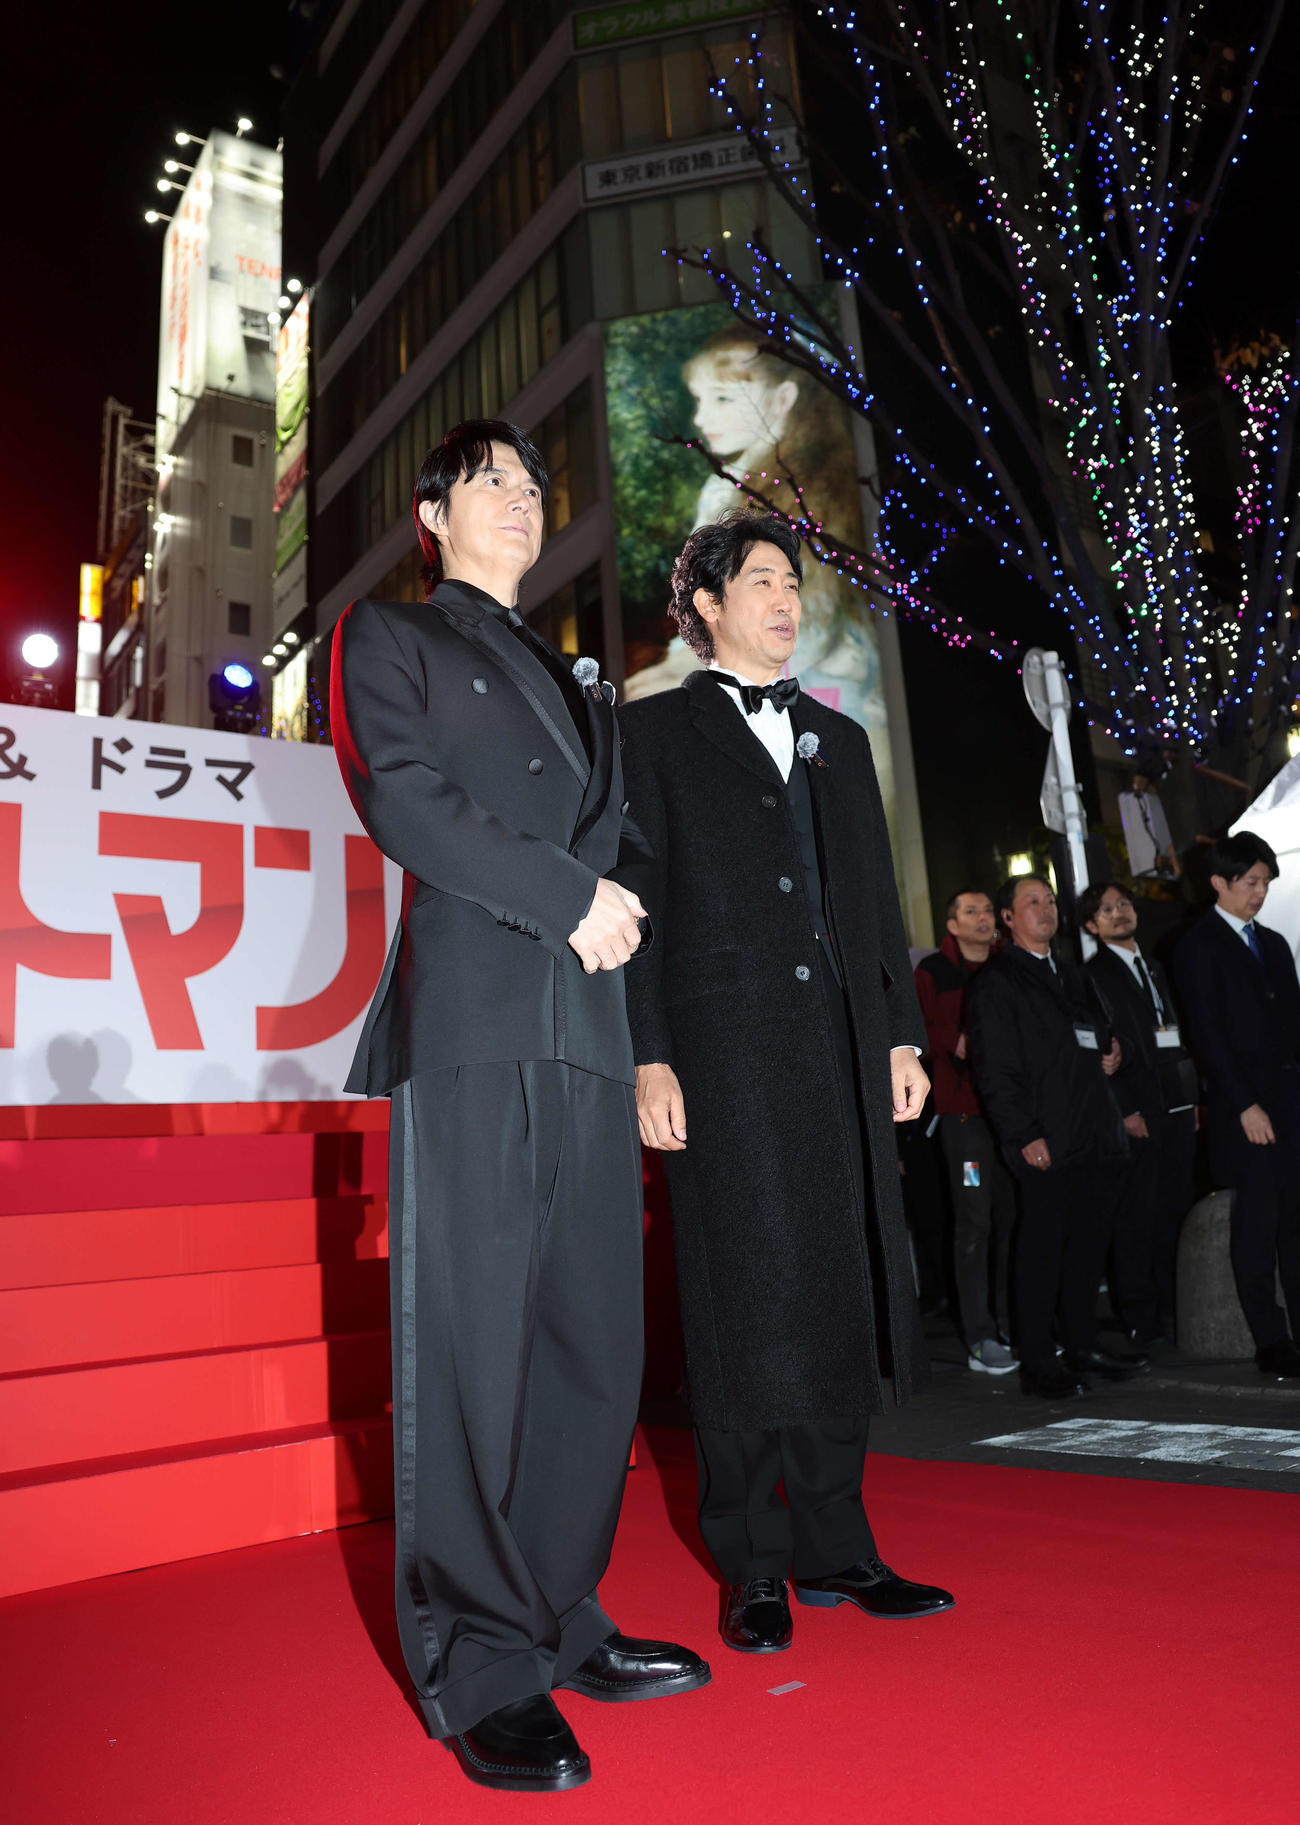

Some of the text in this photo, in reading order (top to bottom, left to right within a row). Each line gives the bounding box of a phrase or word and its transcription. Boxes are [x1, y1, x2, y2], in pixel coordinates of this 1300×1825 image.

[0, 726, 256, 802] & ドラマ
